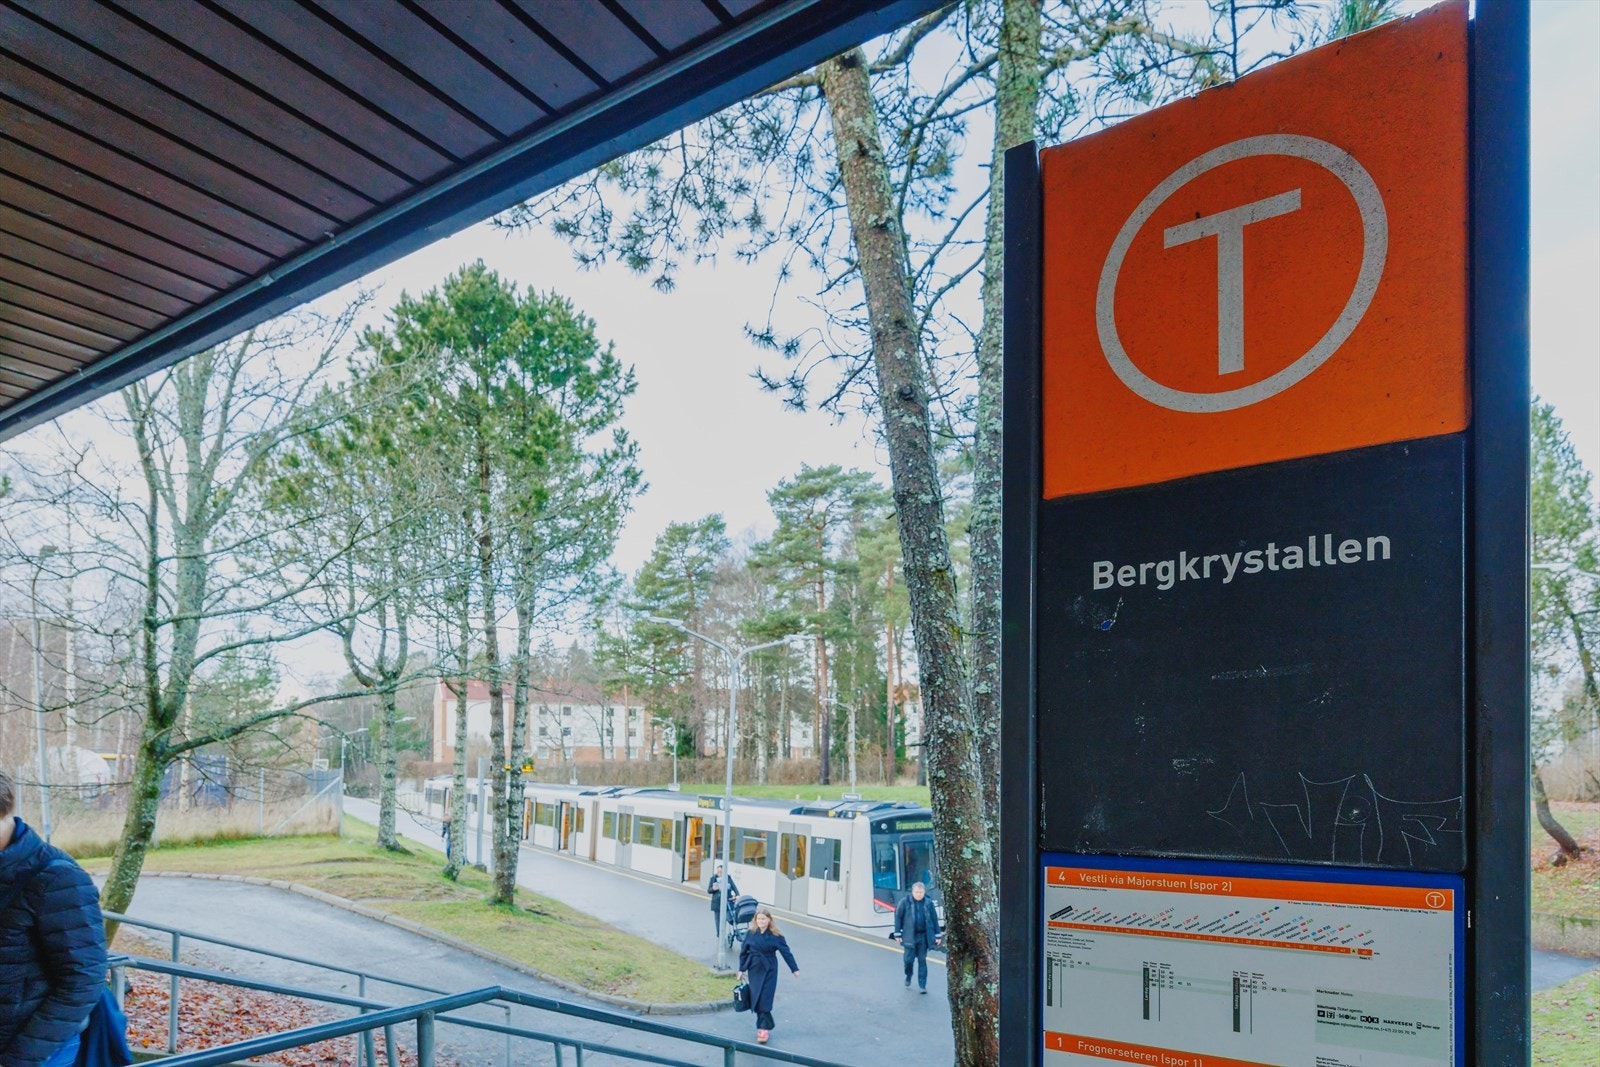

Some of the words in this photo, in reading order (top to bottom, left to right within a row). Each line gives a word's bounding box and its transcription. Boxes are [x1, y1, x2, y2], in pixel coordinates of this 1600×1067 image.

[1092, 532, 1392, 591] Bergkrystallen
[1058, 871, 1066, 882] 4
[1079, 872, 1108, 884] Vestli
[1109, 875, 1124, 885] via
[1127, 876, 1187, 889] Majorstuen
[1189, 878, 1219, 892] (spor
[1221, 880, 1233, 893] 2)
[1056, 1037, 1063, 1048] 1
[1077, 1040, 1158, 1063] Frognerseteren
[1161, 1052, 1190, 1067] (spor
